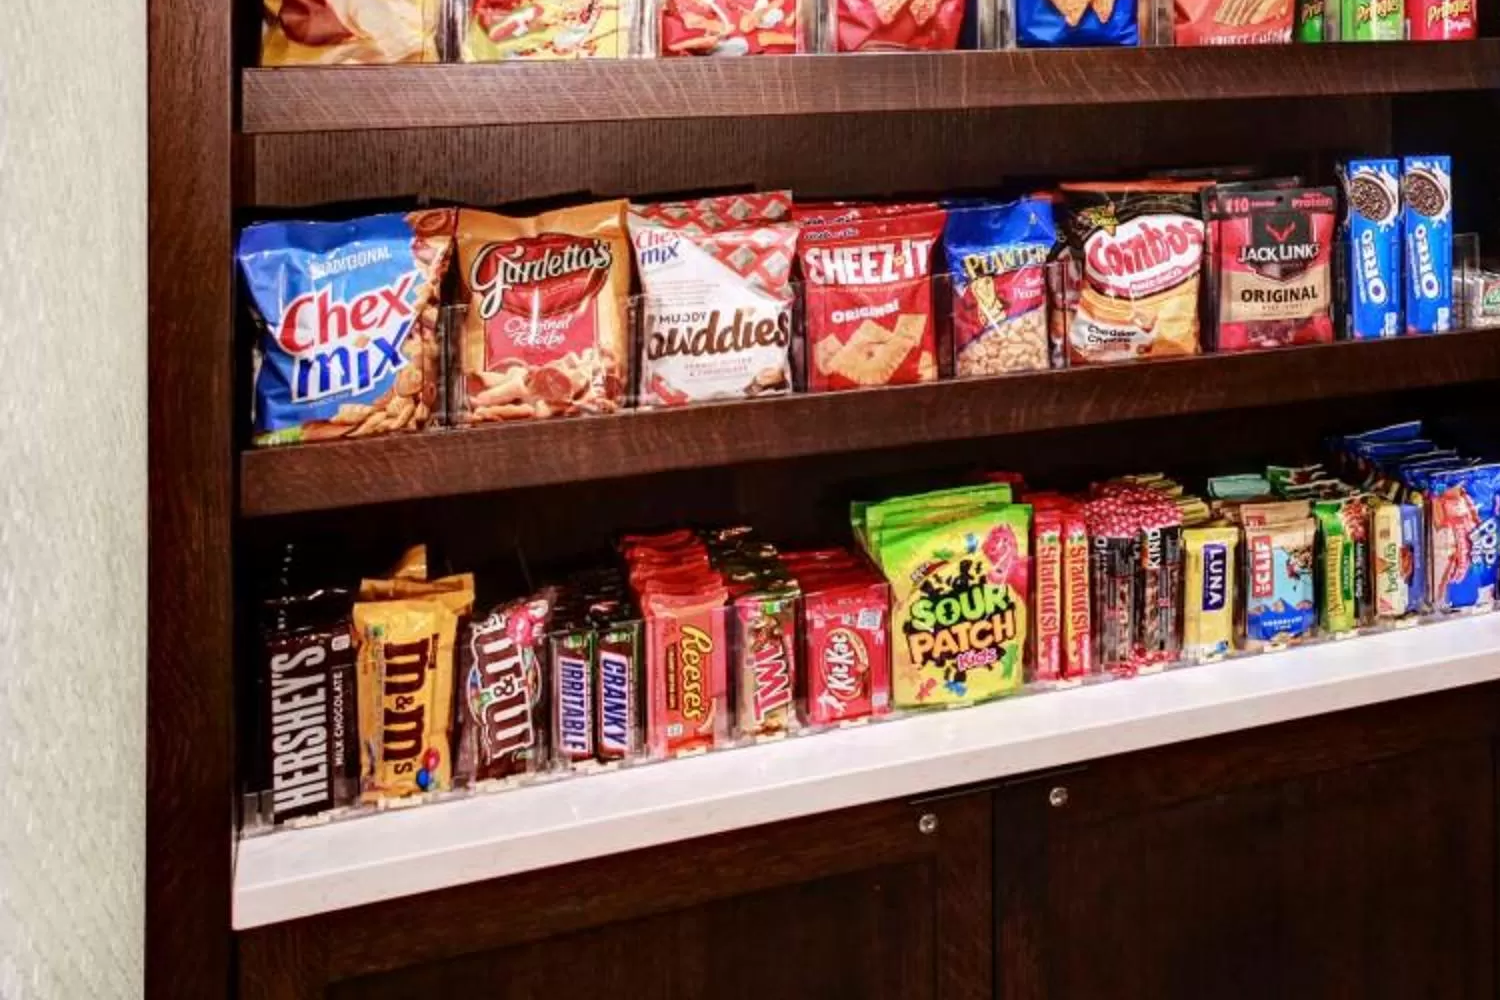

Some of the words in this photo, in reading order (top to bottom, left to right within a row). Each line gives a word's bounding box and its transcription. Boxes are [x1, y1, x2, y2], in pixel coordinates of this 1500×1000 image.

[1087, 220, 1204, 277] Combos
[1237, 246, 1279, 263] JACK
[1361, 228, 1388, 304] OREO
[1414, 222, 1440, 300] OREO
[470, 240, 612, 320] Gardetto's
[1240, 285, 1319, 303] ORIGINAL
[276, 273, 413, 355] Chex
[647, 304, 790, 360] buddies
[1148, 527, 1161, 569] KIND
[1208, 549, 1223, 606] LUNA
[1254, 536, 1272, 583] CLIF
[908, 609, 1015, 664] PATCH
[911, 583, 1009, 631] SOUR
[602, 657, 628, 746] CRANKY
[680, 623, 714, 721] Reese's
[270, 644, 329, 813] HERSHEY'S
[333, 670, 344, 737] CHOCOLATE
[560, 660, 587, 751] IRRITABLE
